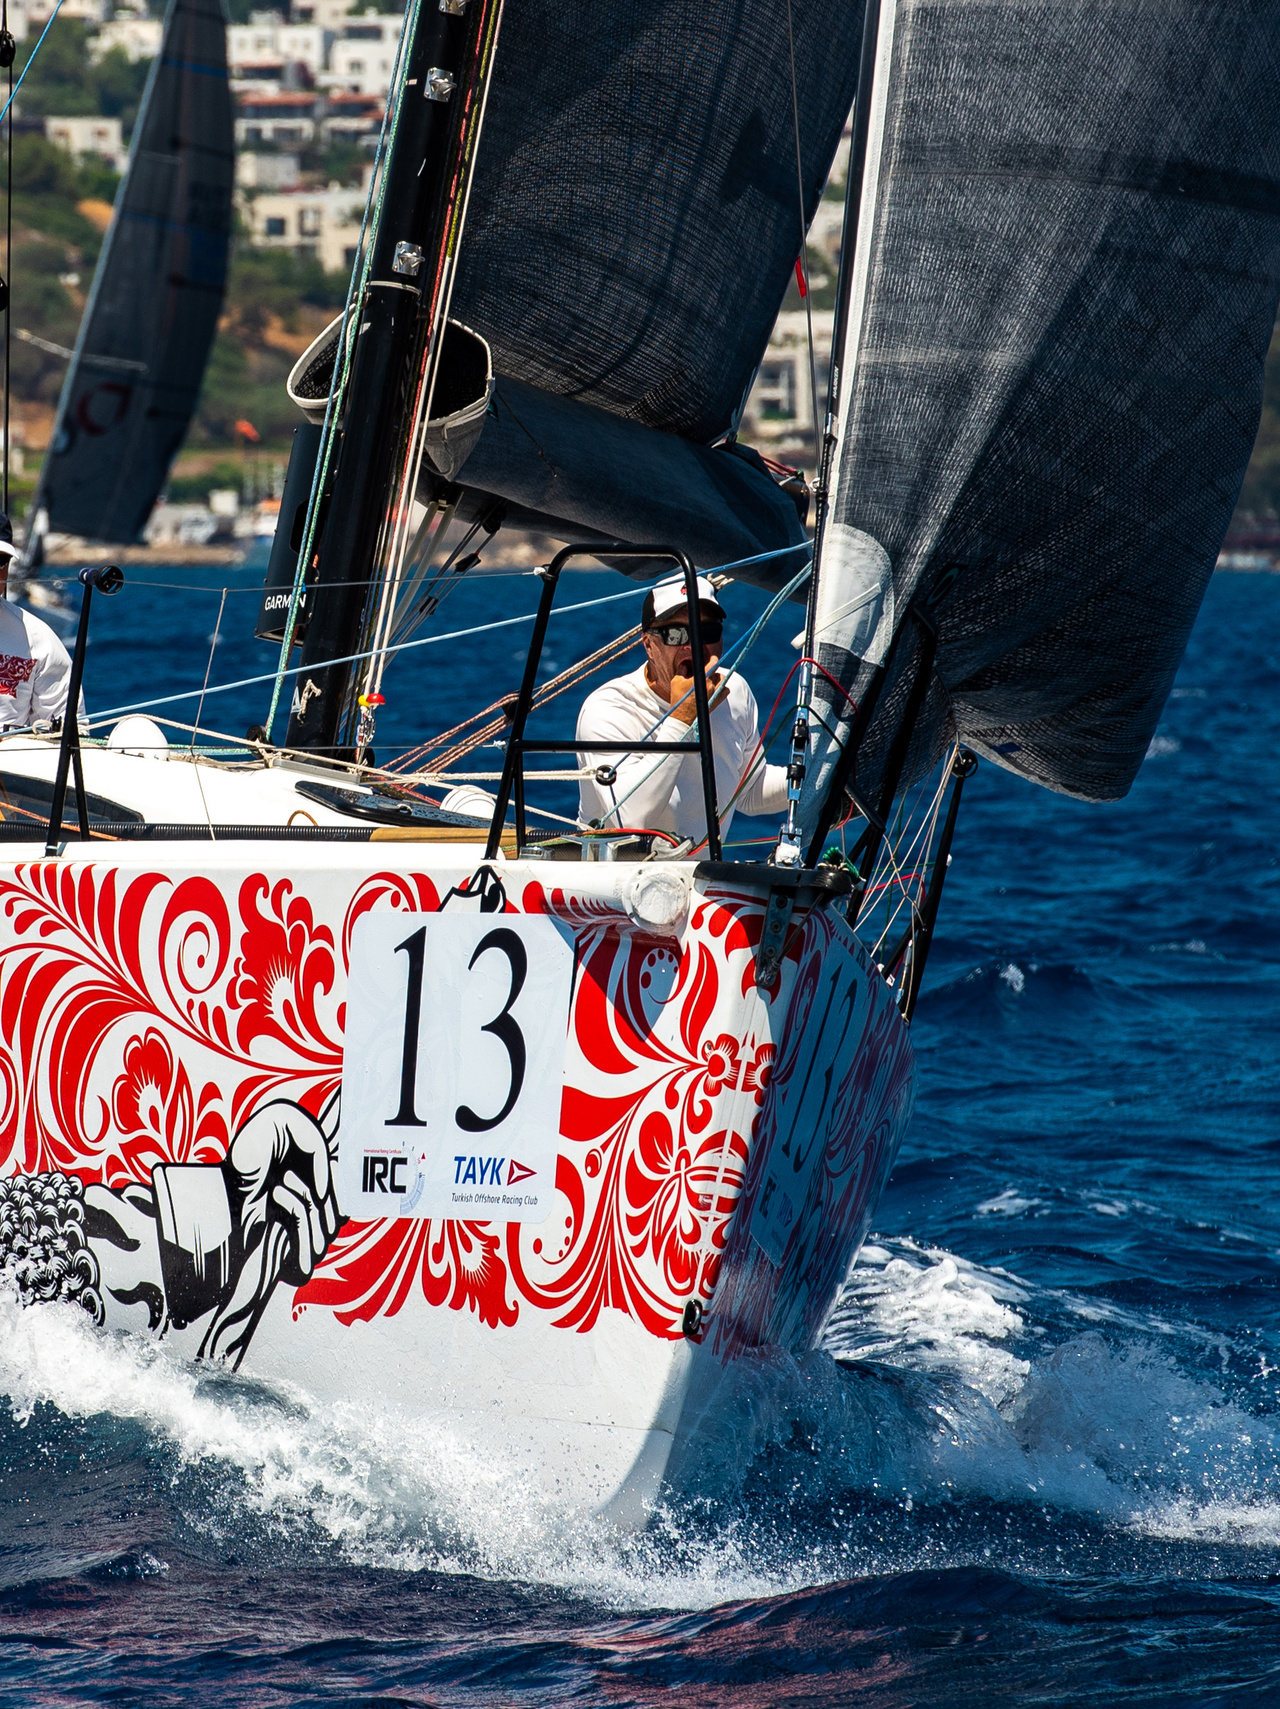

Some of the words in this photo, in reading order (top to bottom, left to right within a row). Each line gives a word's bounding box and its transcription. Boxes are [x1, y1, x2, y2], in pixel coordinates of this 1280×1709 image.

[264, 594, 307, 611] GARMN
[384, 925, 528, 1133] 13
[781, 961, 858, 1174] 13
[362, 1155, 408, 1194] IRC
[453, 1155, 506, 1186] TAYK
[451, 1192, 473, 1203] Turkish
[474, 1193, 501, 1204] Offshore
[501, 1194, 523, 1207] Racing
[523, 1195, 539, 1206] Club
